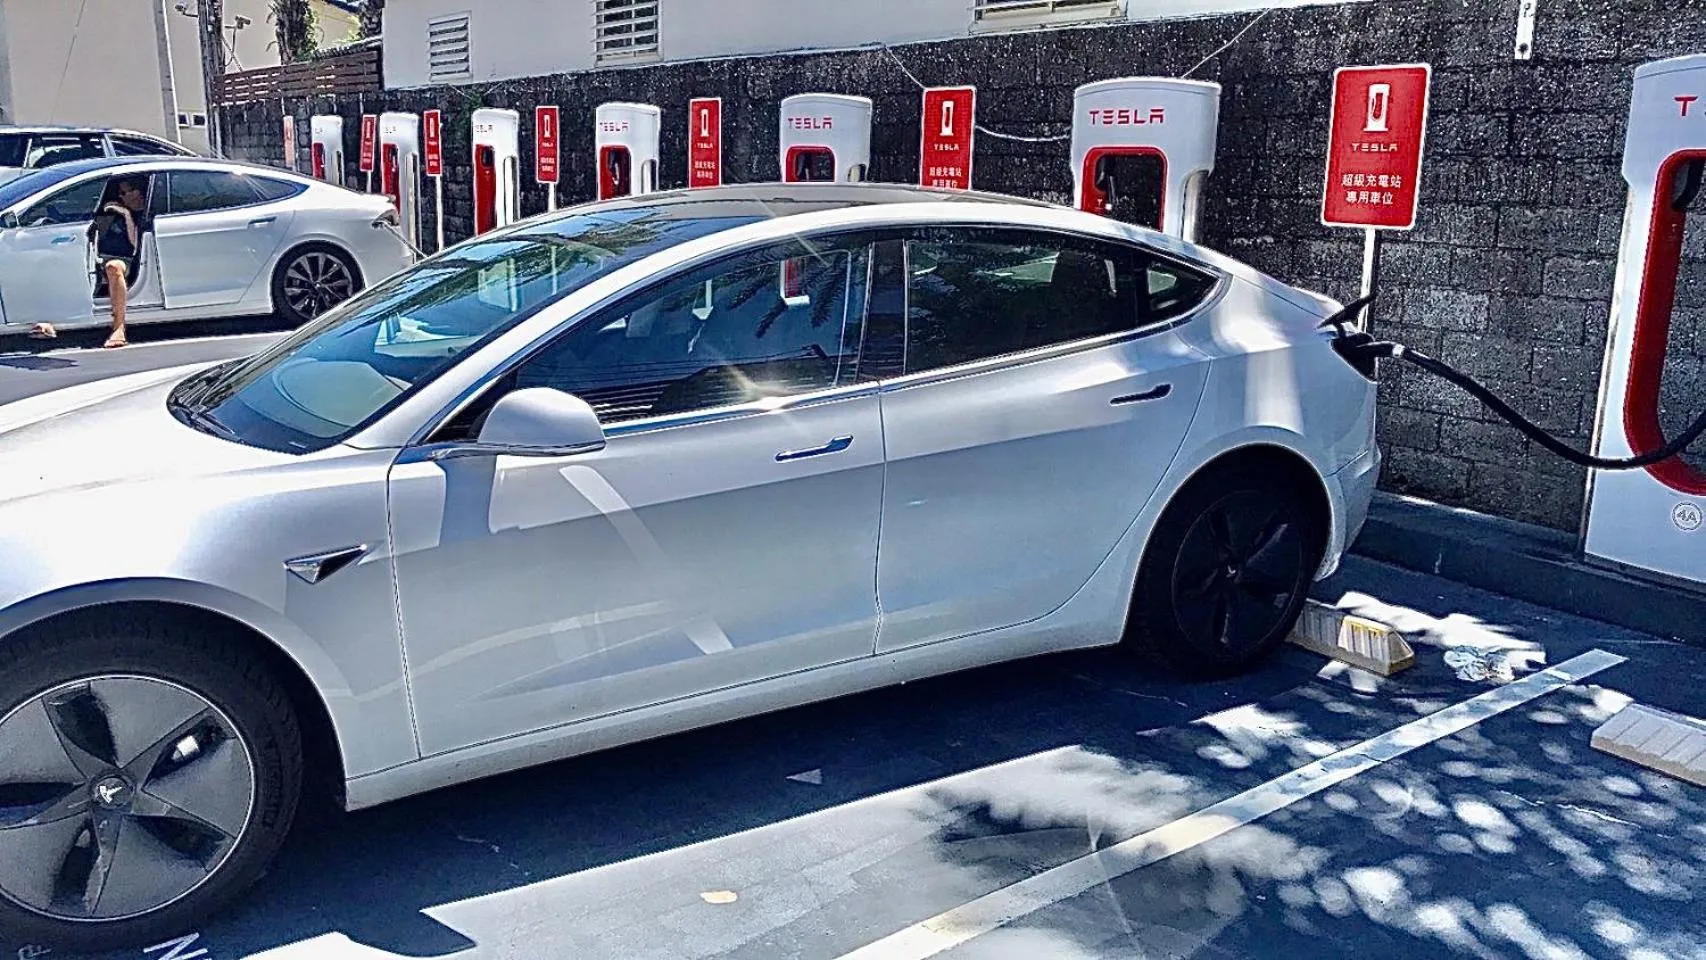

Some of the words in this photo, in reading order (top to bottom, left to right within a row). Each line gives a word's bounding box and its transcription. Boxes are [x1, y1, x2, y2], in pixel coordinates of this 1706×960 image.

[787, 117, 832, 129] TESLA
[1089, 108, 1165, 125] TESLA
[934, 143, 959, 151] TESLA
[1351, 142, 1398, 152] TESLA
[1341, 174, 1402, 188] 超級充電站
[1345, 190, 1394, 205] 專用車位
